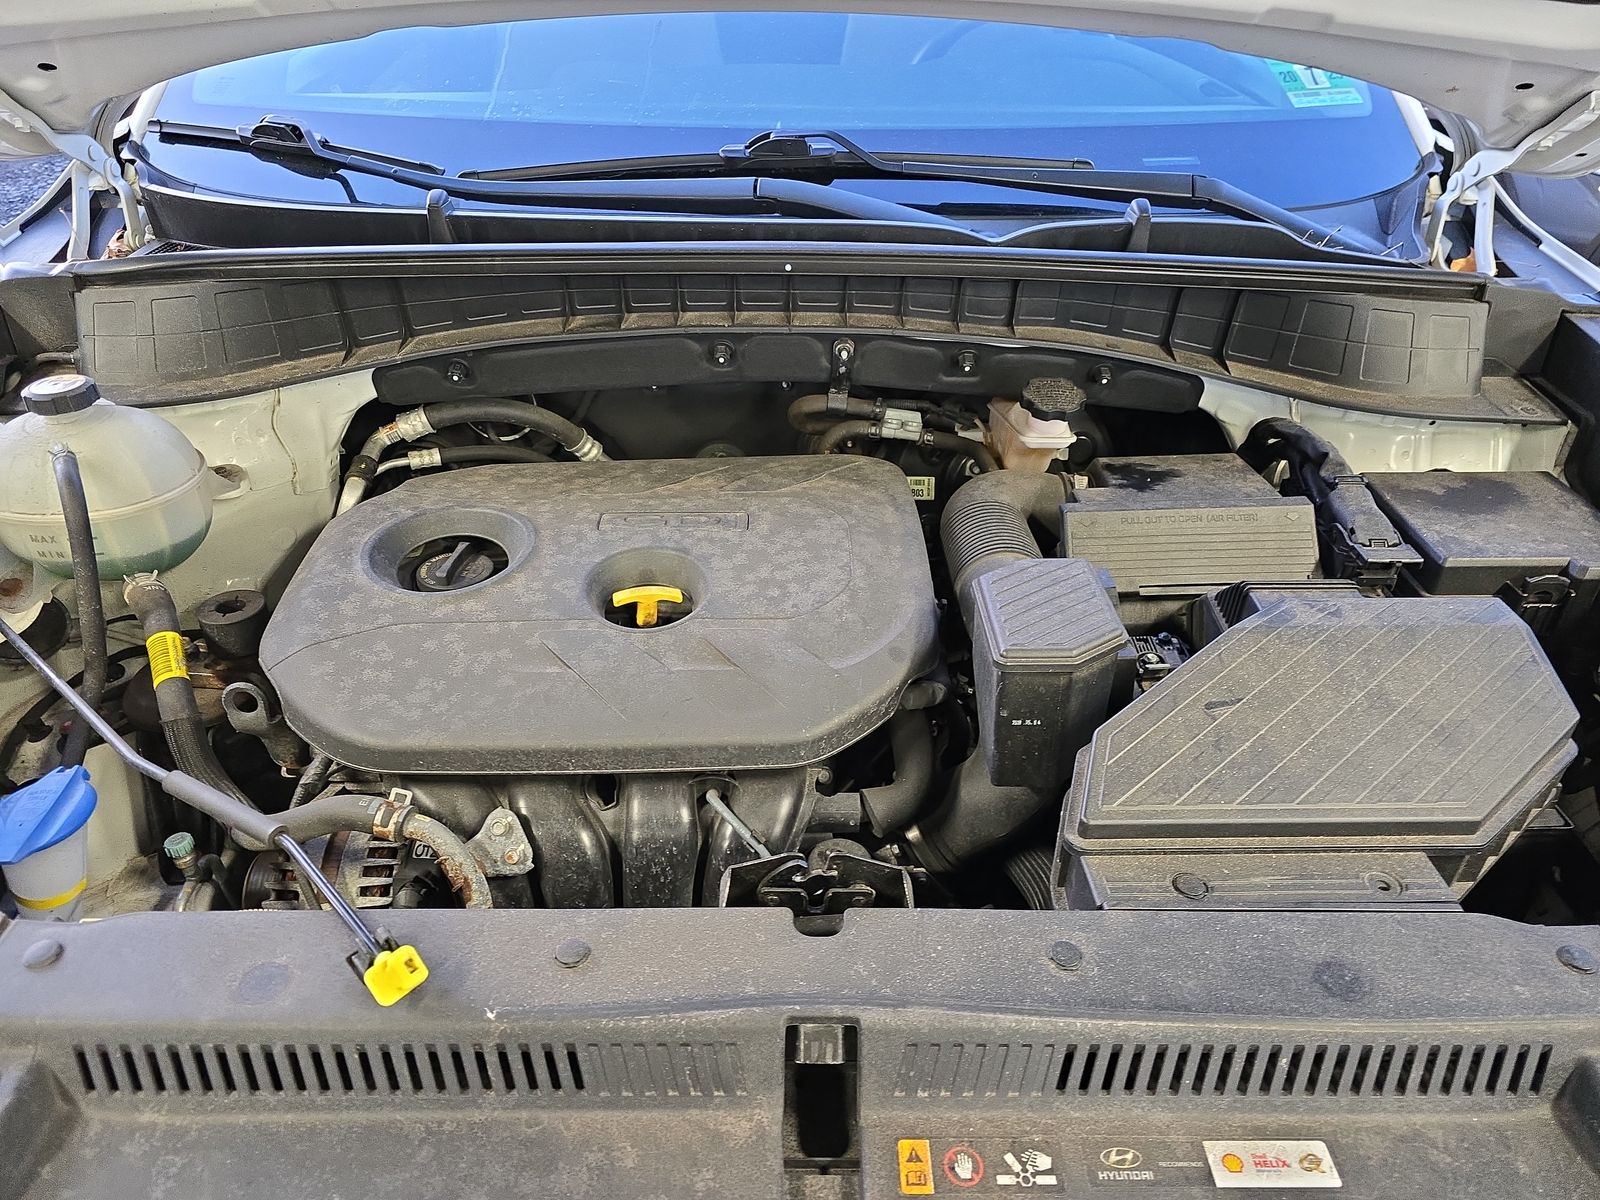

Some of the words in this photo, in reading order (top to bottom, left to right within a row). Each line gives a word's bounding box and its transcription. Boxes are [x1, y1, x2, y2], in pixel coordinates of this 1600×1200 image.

[29, 534, 57, 544] MAX
[37, 550, 65, 559] MIN
[1254, 1160, 1291, 1168] HELIX
[1098, 1170, 1154, 1180] HYUNDAI
